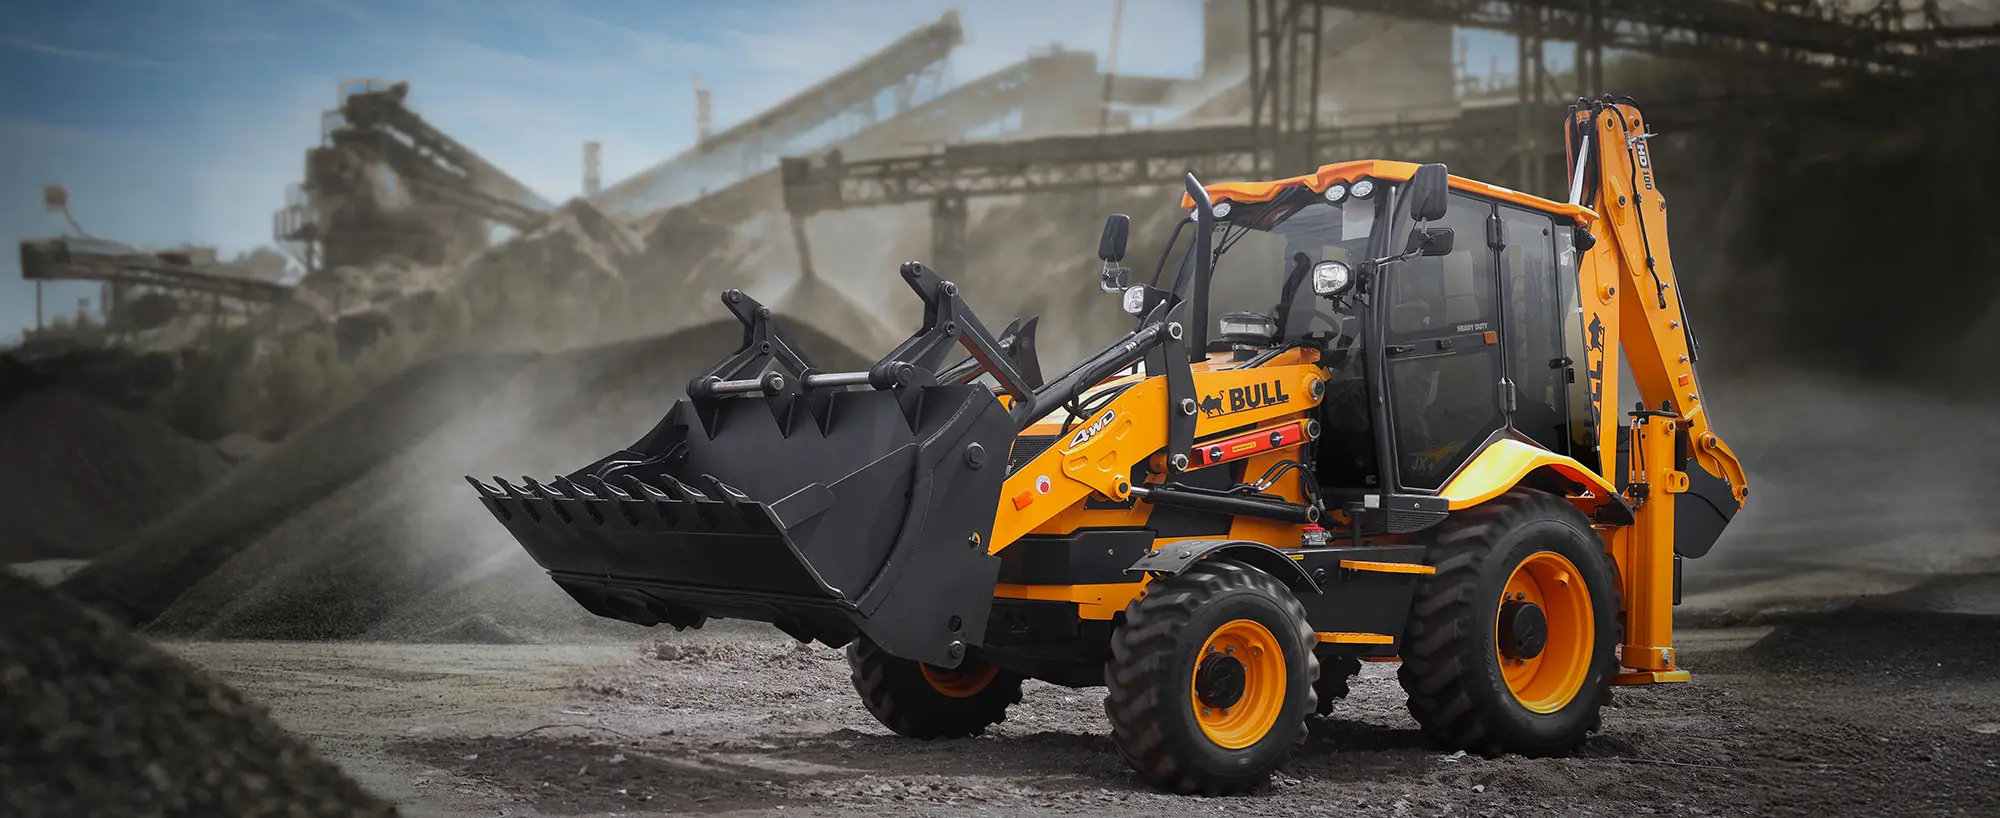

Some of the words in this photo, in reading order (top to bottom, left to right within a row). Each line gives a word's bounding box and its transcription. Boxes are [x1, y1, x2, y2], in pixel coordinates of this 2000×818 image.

[1643, 170, 1652, 190] 100
[1457, 324, 1474, 332] HEAVY
[1474, 322, 1488, 331] DUTY
[1229, 379, 1290, 411] BULL
[1069, 409, 1116, 449] 4WD
